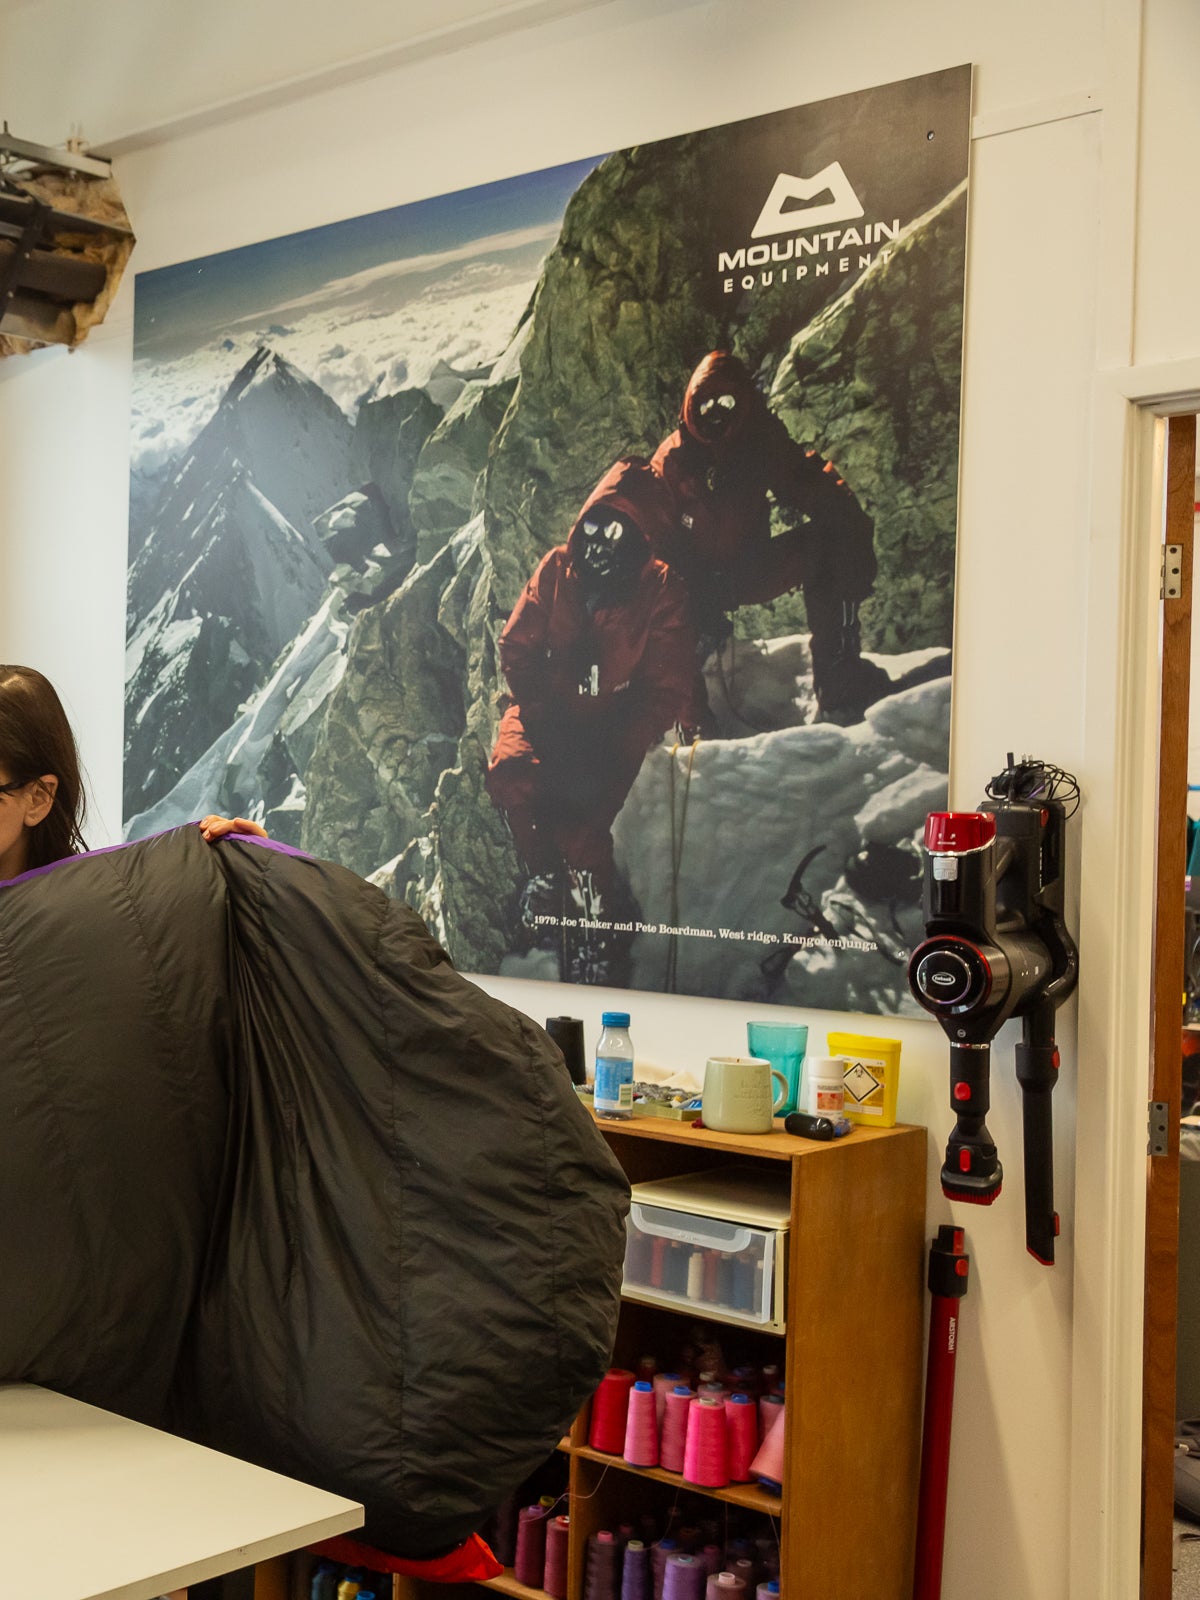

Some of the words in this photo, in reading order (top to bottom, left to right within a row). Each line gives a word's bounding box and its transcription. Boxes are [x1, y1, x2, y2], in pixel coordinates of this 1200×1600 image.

[718, 219, 900, 272] MOUNTAIN
[724, 251, 892, 293] EQUIPMENT
[534, 915, 559, 926] 1979:
[561, 917, 577, 926] Joe
[579, 918, 611, 930] Tasker
[614, 921, 633, 931] and
[635, 922, 657, 933] Pete
[659, 924, 716, 938] Boardman,
[719, 928, 745, 940] West
[747, 931, 780, 944] ridge,
